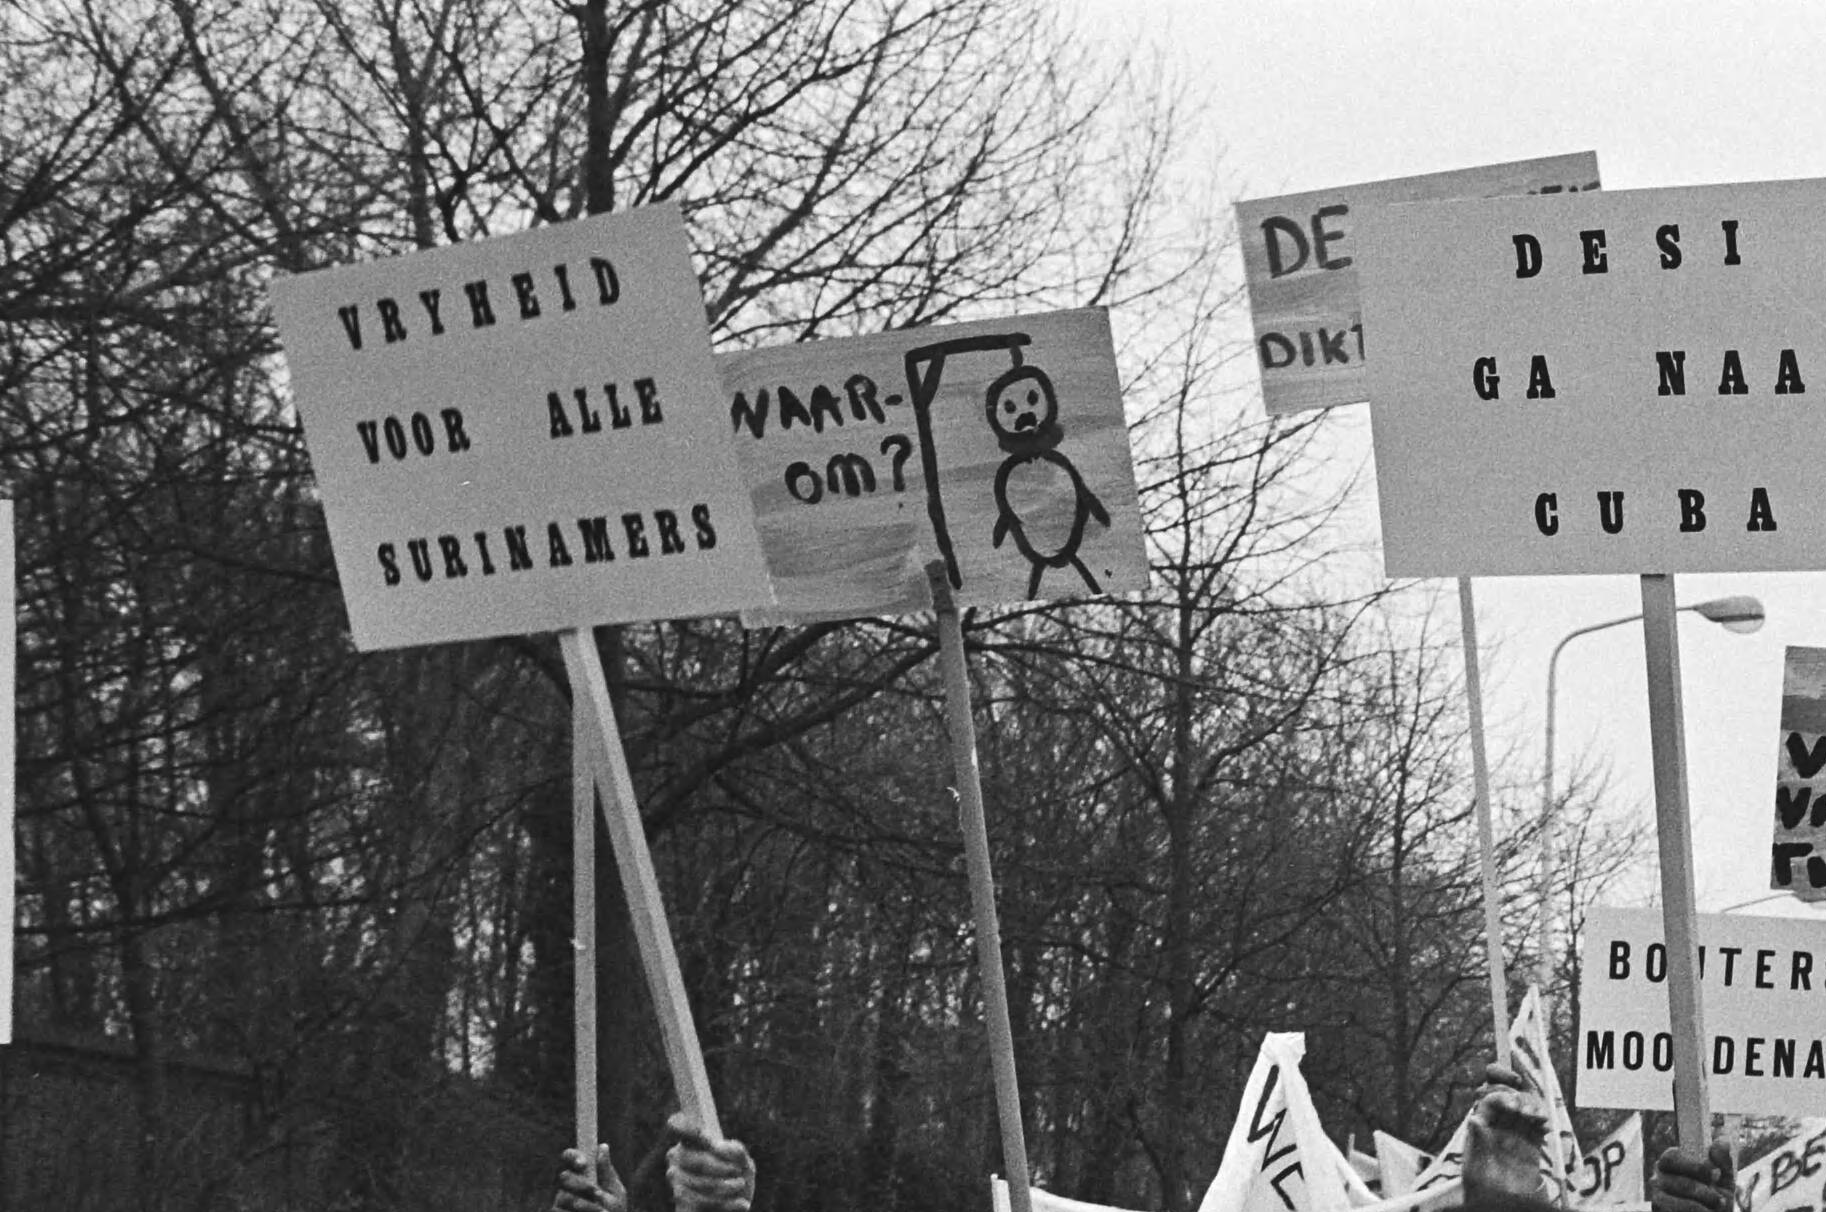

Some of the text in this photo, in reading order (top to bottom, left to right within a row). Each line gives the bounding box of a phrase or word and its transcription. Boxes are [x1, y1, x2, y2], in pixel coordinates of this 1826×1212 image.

[1511, 219, 1742, 279] DESI
[338, 257, 621, 351] VRYHEID
[1472, 354, 1556, 401] GA
[356, 376, 664, 464] VOOR ALLE
[377, 503, 717, 586] SURINAMERS
[1533, 486, 1777, 536] CUBA
